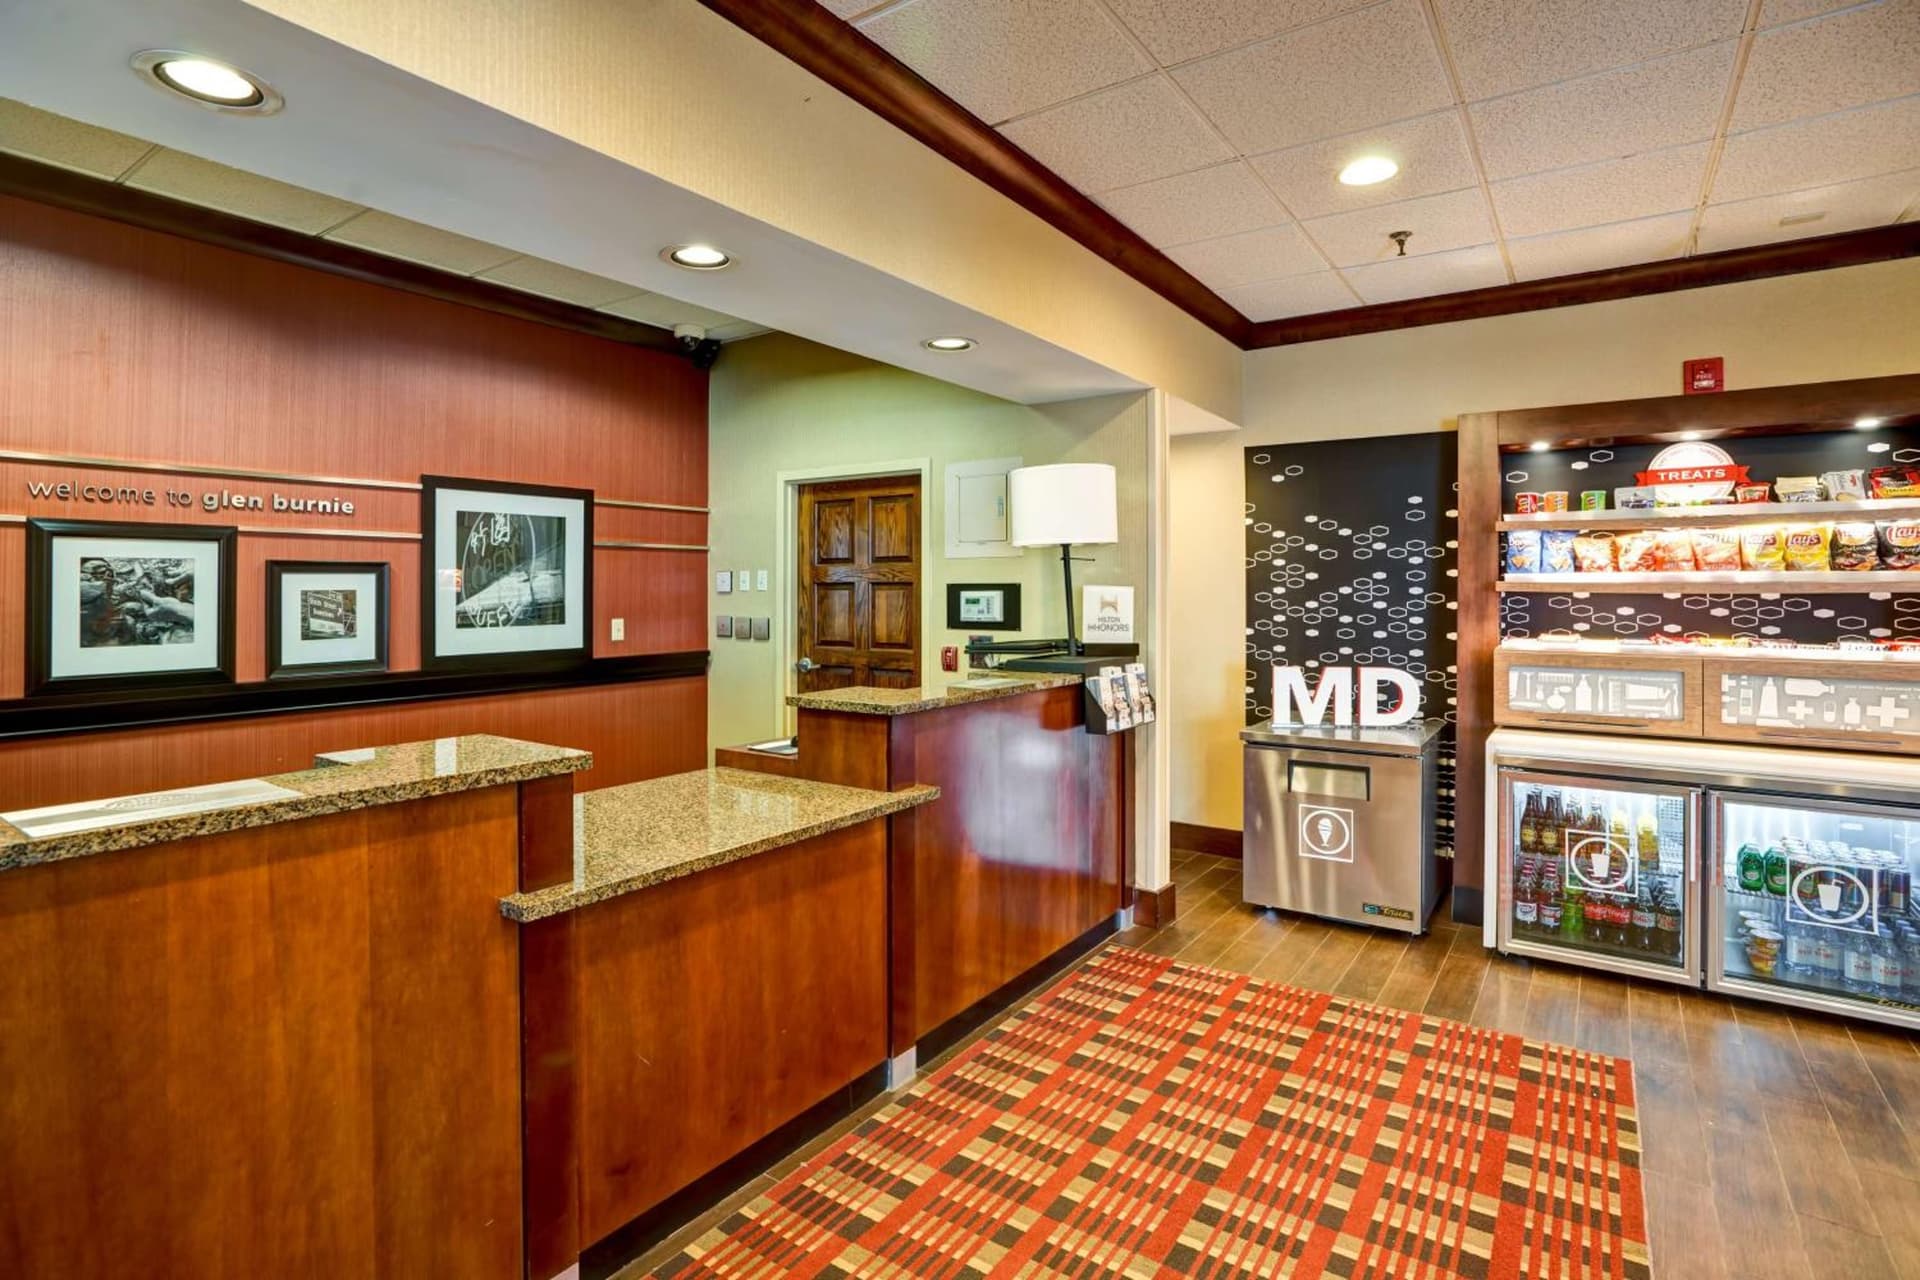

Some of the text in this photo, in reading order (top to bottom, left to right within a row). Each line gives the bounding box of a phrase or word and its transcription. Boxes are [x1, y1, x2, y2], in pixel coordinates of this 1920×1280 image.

[1657, 468, 1726, 481] TREATS
[28, 480, 355, 515] welcome to glen burnie
[1786, 534, 1821, 547] Lays
[1271, 665, 1421, 727] MD
